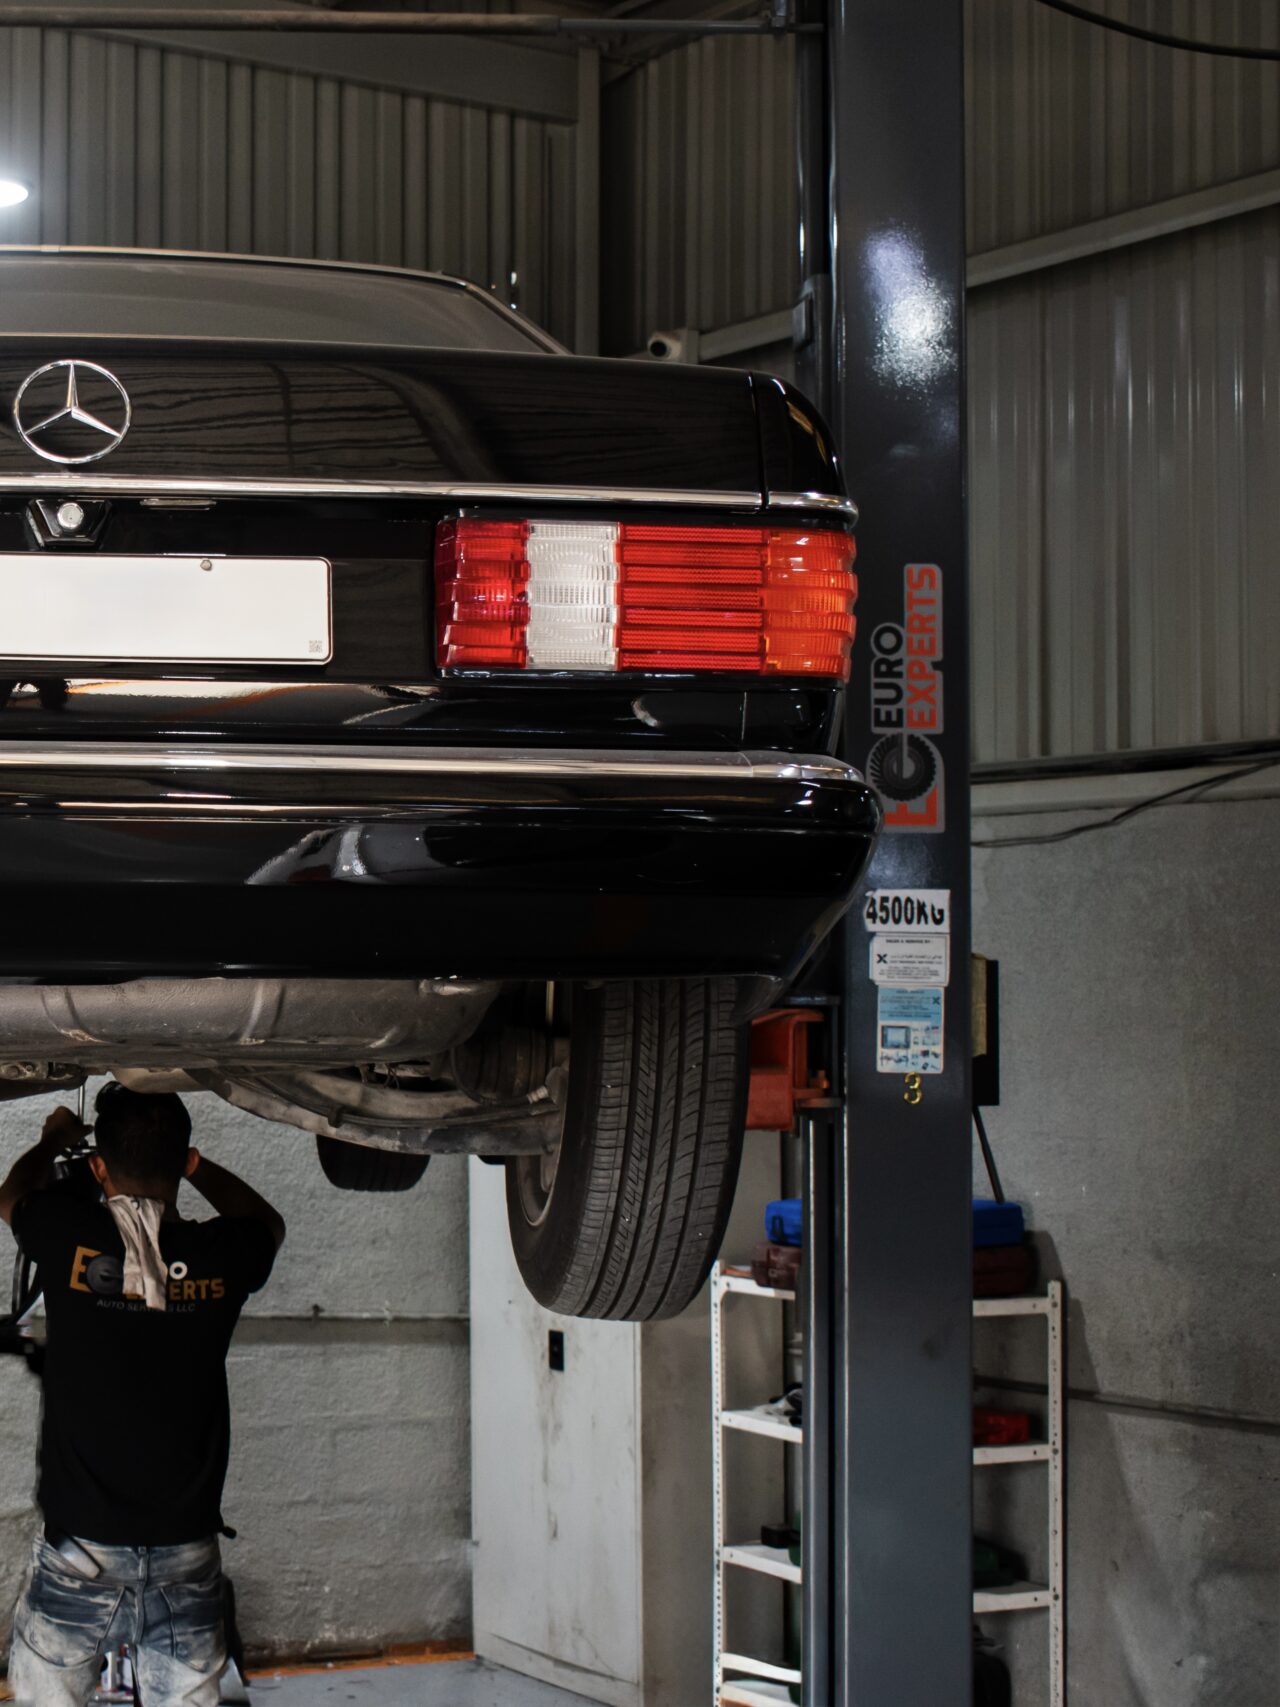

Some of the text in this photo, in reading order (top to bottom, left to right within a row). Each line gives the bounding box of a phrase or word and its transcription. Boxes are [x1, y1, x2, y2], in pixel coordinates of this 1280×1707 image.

[906, 566, 937, 729] EXPERTS
[873, 625, 903, 728] EURO
[866, 895, 945, 926] 4500KG
[903, 1072, 923, 1104] 3
[96, 1298, 125, 1310] AUTO
[176, 1302, 196, 1313] LLC
